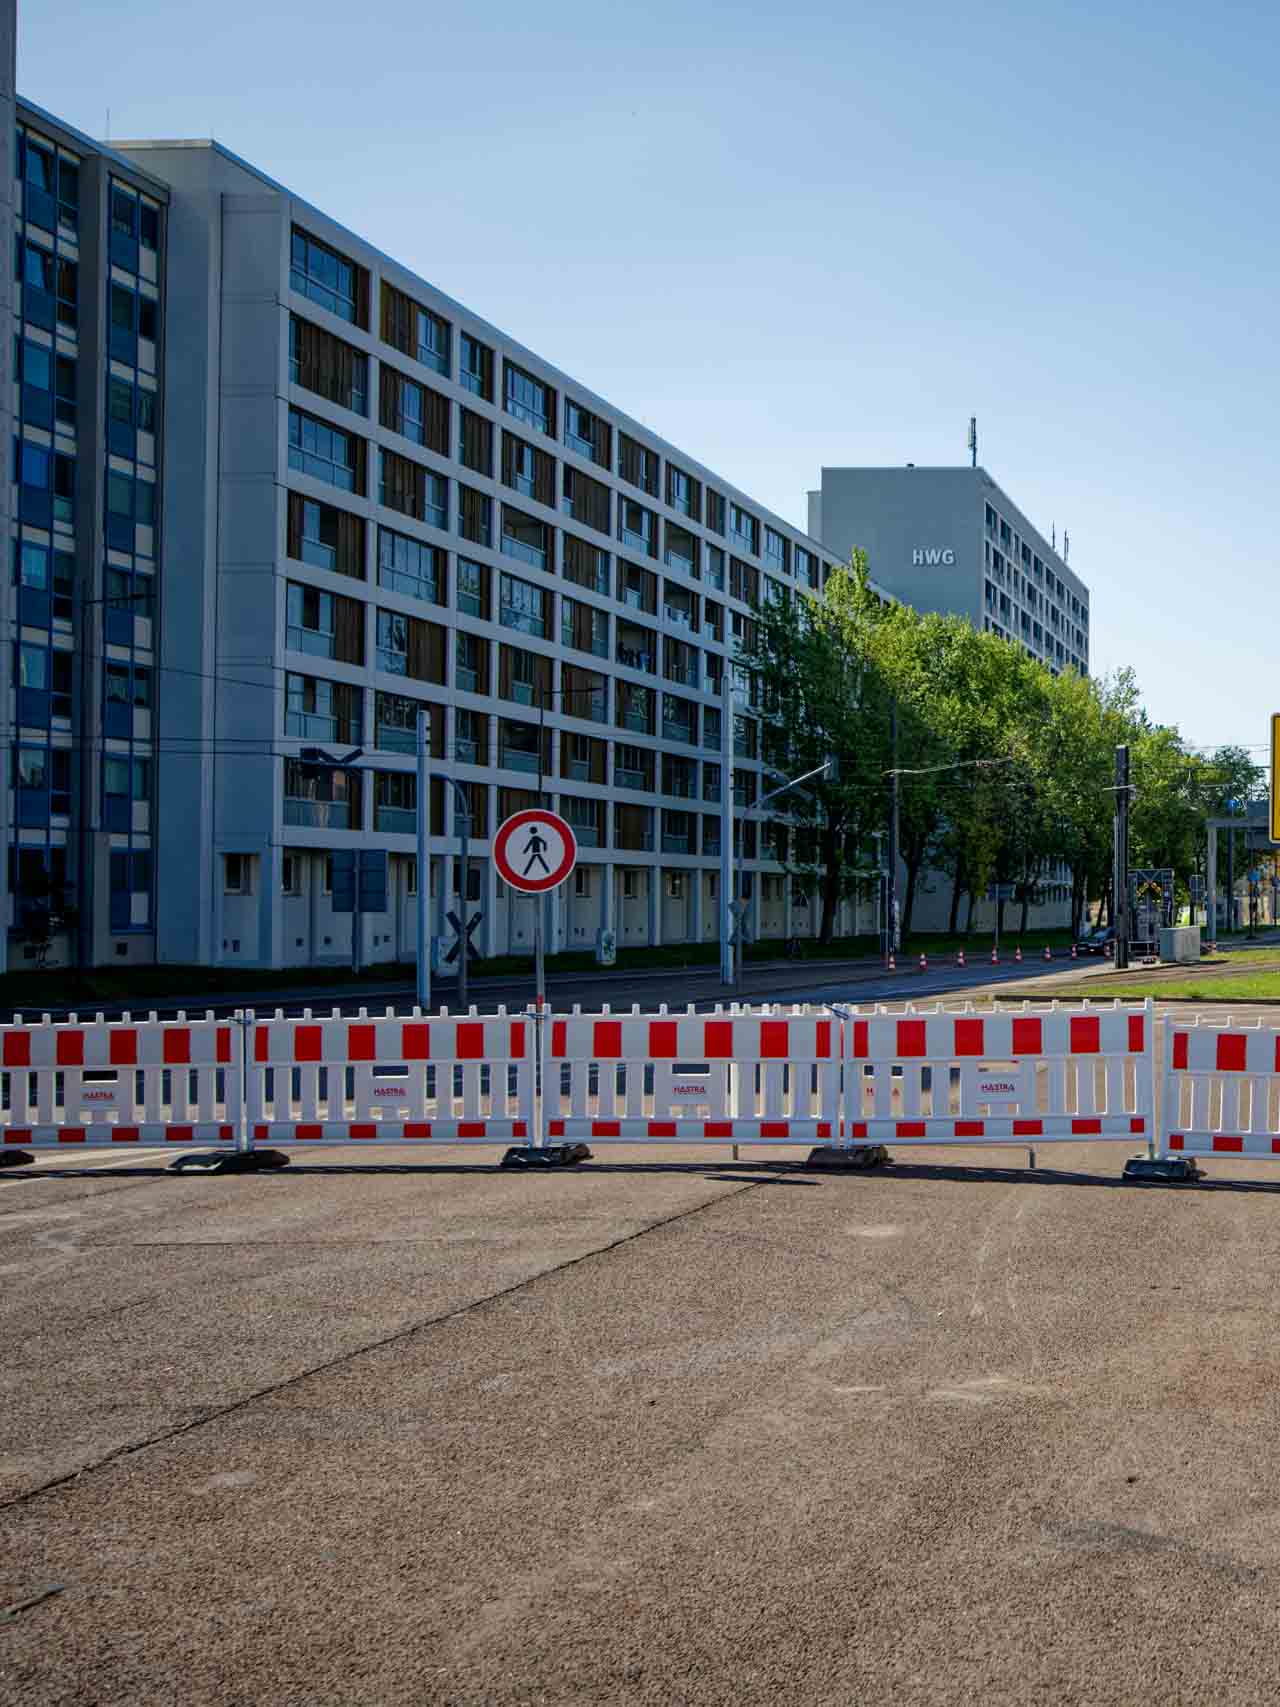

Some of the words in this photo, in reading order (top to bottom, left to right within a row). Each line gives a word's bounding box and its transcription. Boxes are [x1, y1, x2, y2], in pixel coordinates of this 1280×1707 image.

[912, 549, 954, 565] HWG
[374, 1087, 406, 1096] HASTRA
[673, 1086, 706, 1094] HASTRA
[981, 1083, 1015, 1092] HASTRA
